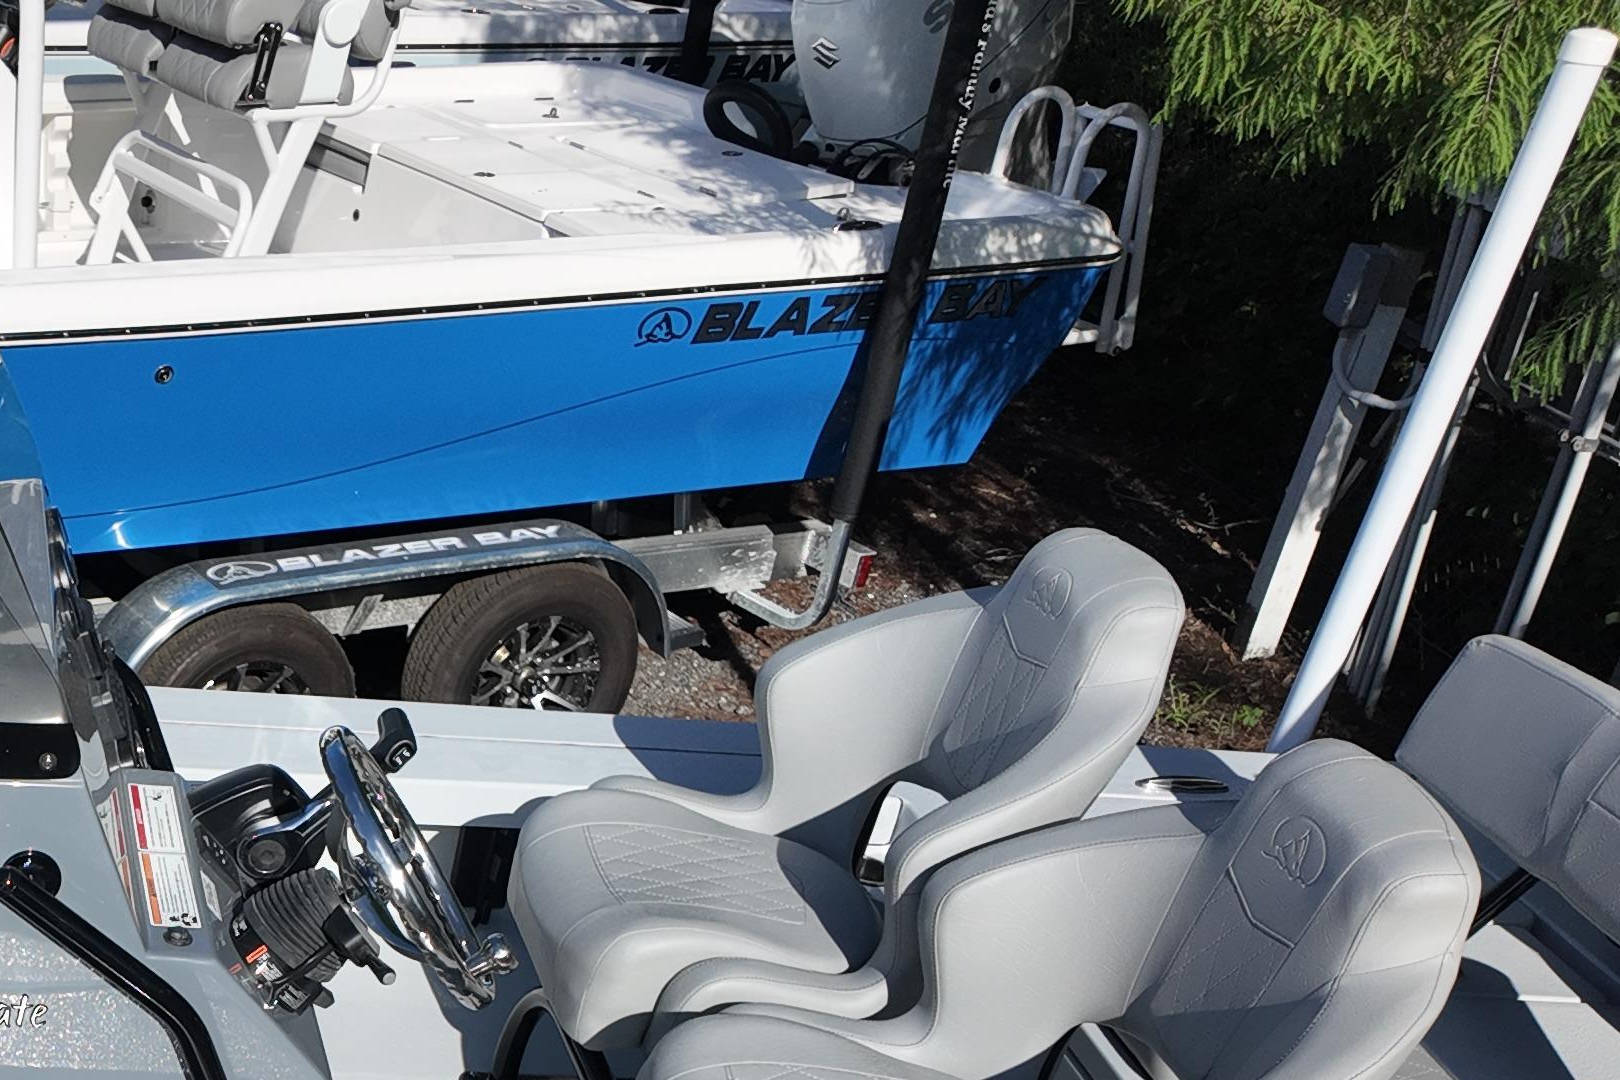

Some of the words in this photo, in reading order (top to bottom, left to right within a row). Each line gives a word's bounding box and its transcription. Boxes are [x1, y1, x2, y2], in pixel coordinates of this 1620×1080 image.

[717, 53, 797, 83] BAY
[691, 291, 879, 344] BLAZE
[925, 275, 1048, 325] BAY
[275, 536, 468, 572] BLAZER
[474, 524, 563, 547] BAY
